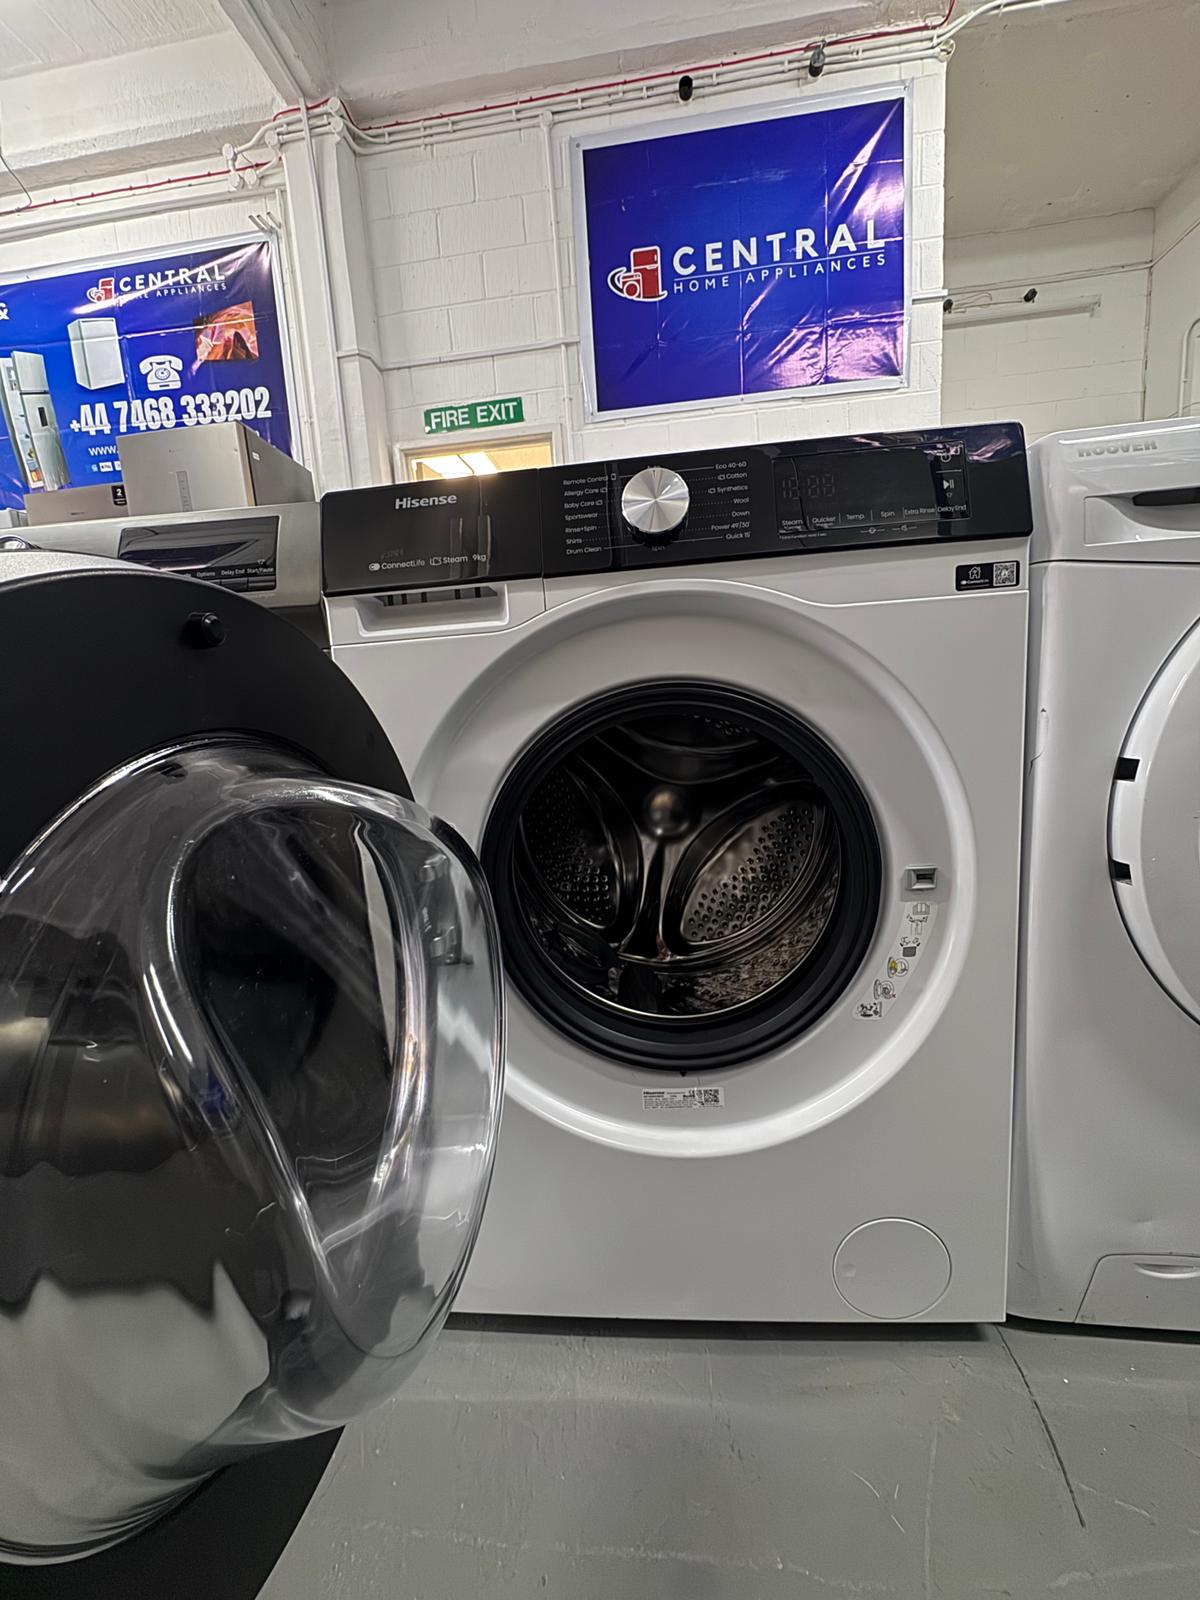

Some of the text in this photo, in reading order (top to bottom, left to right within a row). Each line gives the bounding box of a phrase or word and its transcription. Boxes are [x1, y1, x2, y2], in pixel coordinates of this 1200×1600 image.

[673, 220, 886, 276] CENTRAL
[119, 265, 226, 292] CENTRAL
[673, 254, 886, 294] HOME APPLIANCES
[156, 283, 227, 298] APPLIANCES
[70, 386, 272, 436] +44 7468 333202
[430, 401, 518, 430] FIRE EXIT
[1078, 440, 1158, 457] HOOVER
[728, 461, 747, 469] 40-60
[587, 475, 608, 483] Control
[726, 472, 748, 480] Cotton
[564, 489, 583, 497] Allergy
[717, 484, 748, 494] Synthetics
[395, 494, 458, 510] Hisense
[904, 508, 919, 516] Extra
[937, 504, 967, 514] Delay End
[564, 512, 598, 521] Sportswear
[731, 510, 750, 518] Down
[846, 513, 865, 522] Temp
[880, 510, 895, 519] Spin
[782, 518, 803, 526] Steam
[811, 516, 836, 525] Quicker
[711, 523, 730, 532] Power
[725, 532, 743, 540] Quick
[566, 548, 583, 556] Drum
[443, 555, 469, 564] Steam
[472, 553, 487, 562] 9kg
